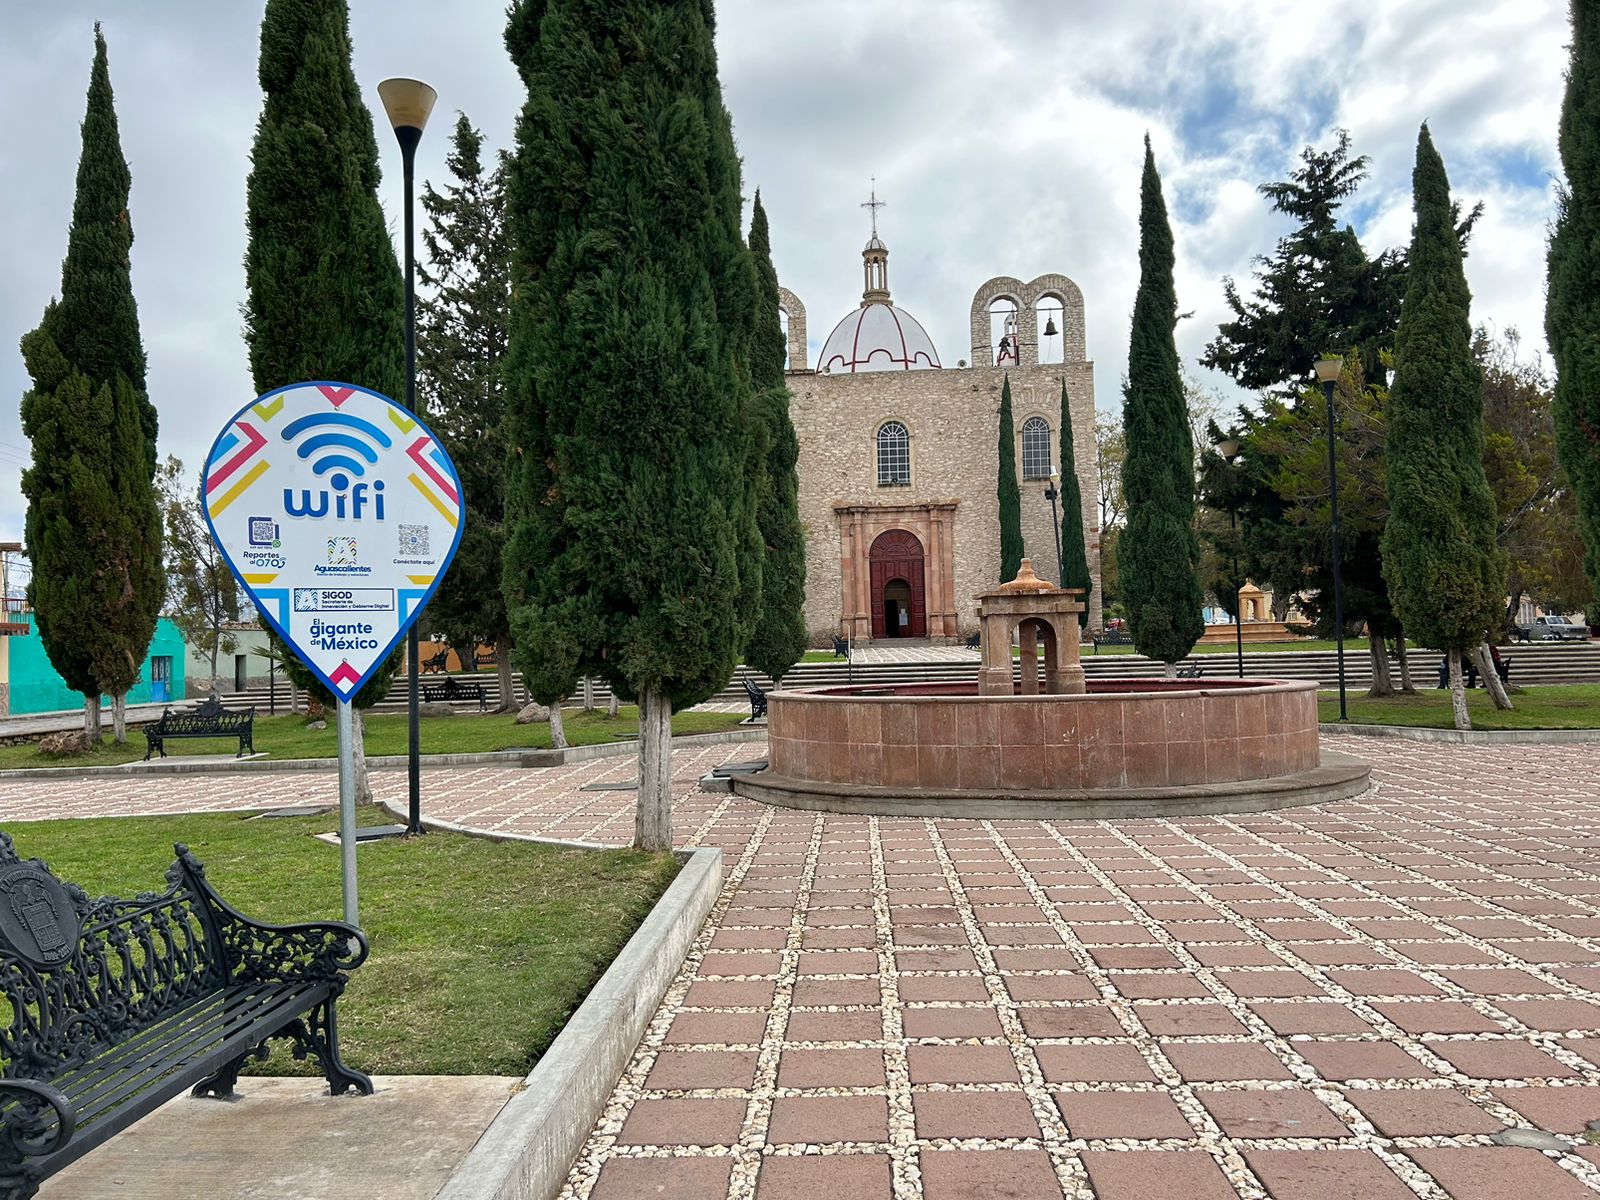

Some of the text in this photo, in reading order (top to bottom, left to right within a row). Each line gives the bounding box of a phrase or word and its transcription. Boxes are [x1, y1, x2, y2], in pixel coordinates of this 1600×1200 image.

[283, 473, 385, 520] wifi
[243, 551, 280, 560] Reportes
[314, 564, 371, 573] Aguascalientes
[322, 591, 352, 599] SIGOD
[310, 622, 372, 637] gigante
[310, 637, 378, 650] de México
